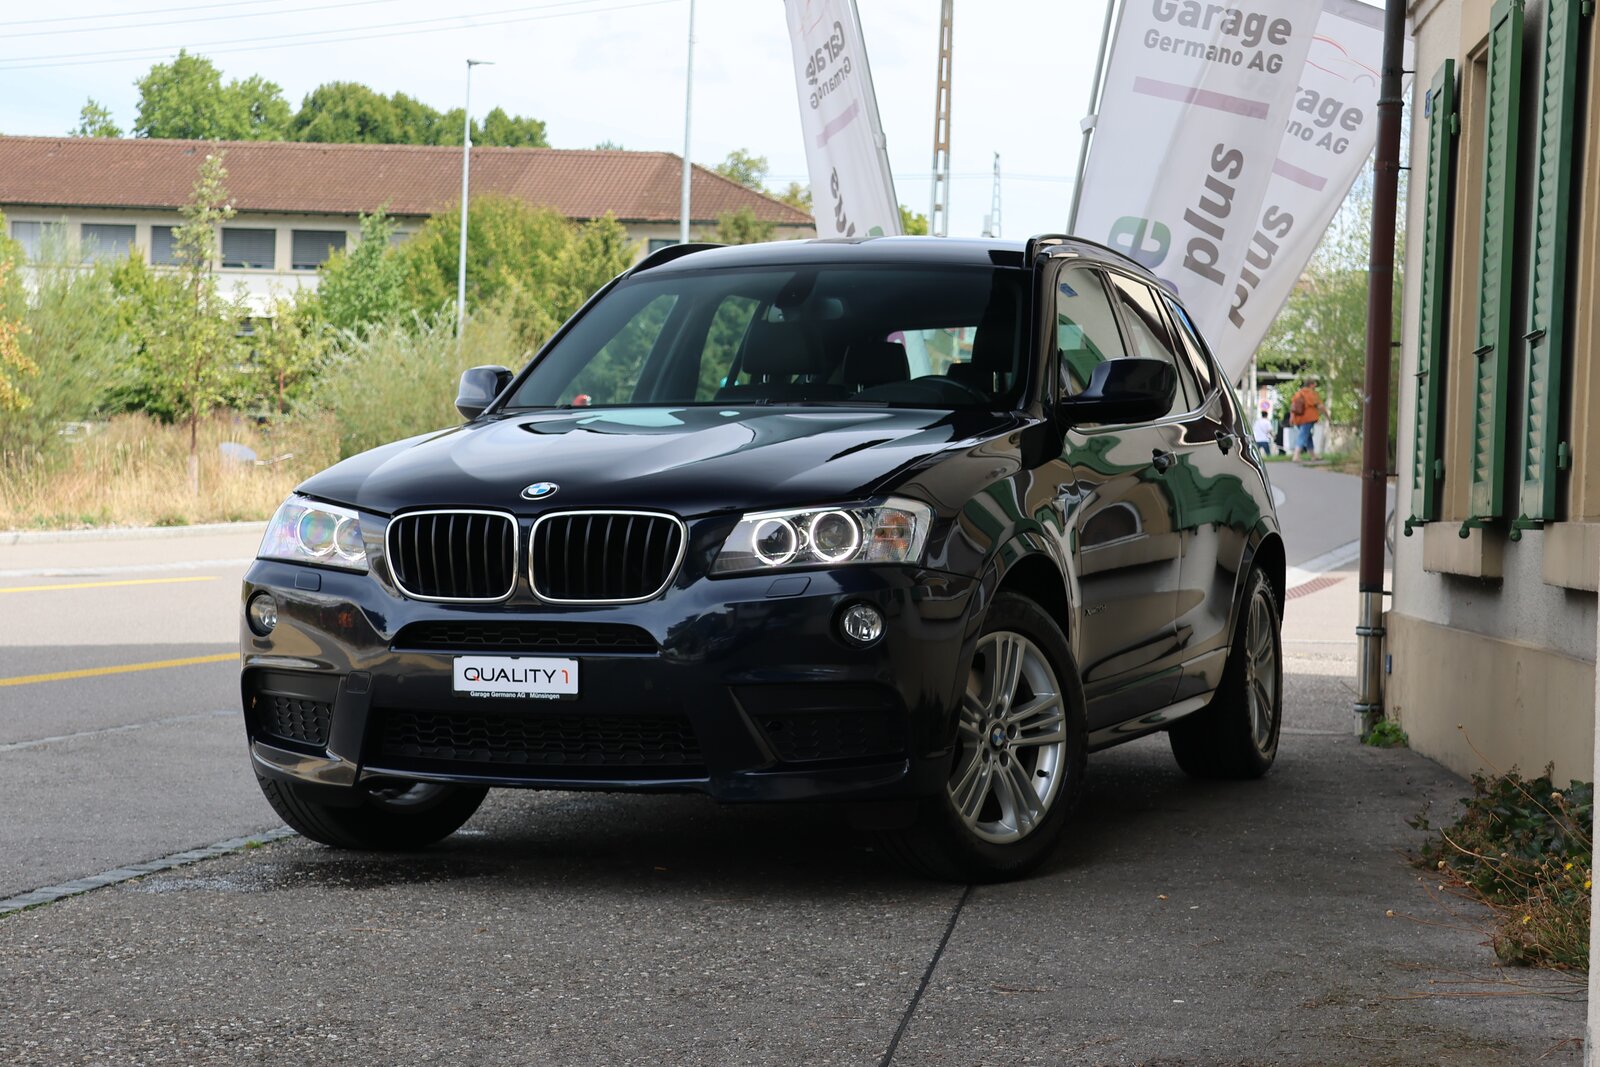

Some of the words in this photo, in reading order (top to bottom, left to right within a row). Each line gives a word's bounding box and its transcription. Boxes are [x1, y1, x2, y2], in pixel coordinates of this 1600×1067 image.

[1152, 0, 1293, 48] Garage
[1144, 28, 1244, 67] Germano
[1246, 50, 1284, 74] AG
[1315, 131, 1350, 155] AG
[1182, 142, 1244, 287] plus
[530, 692, 560, 700] Münsingen
